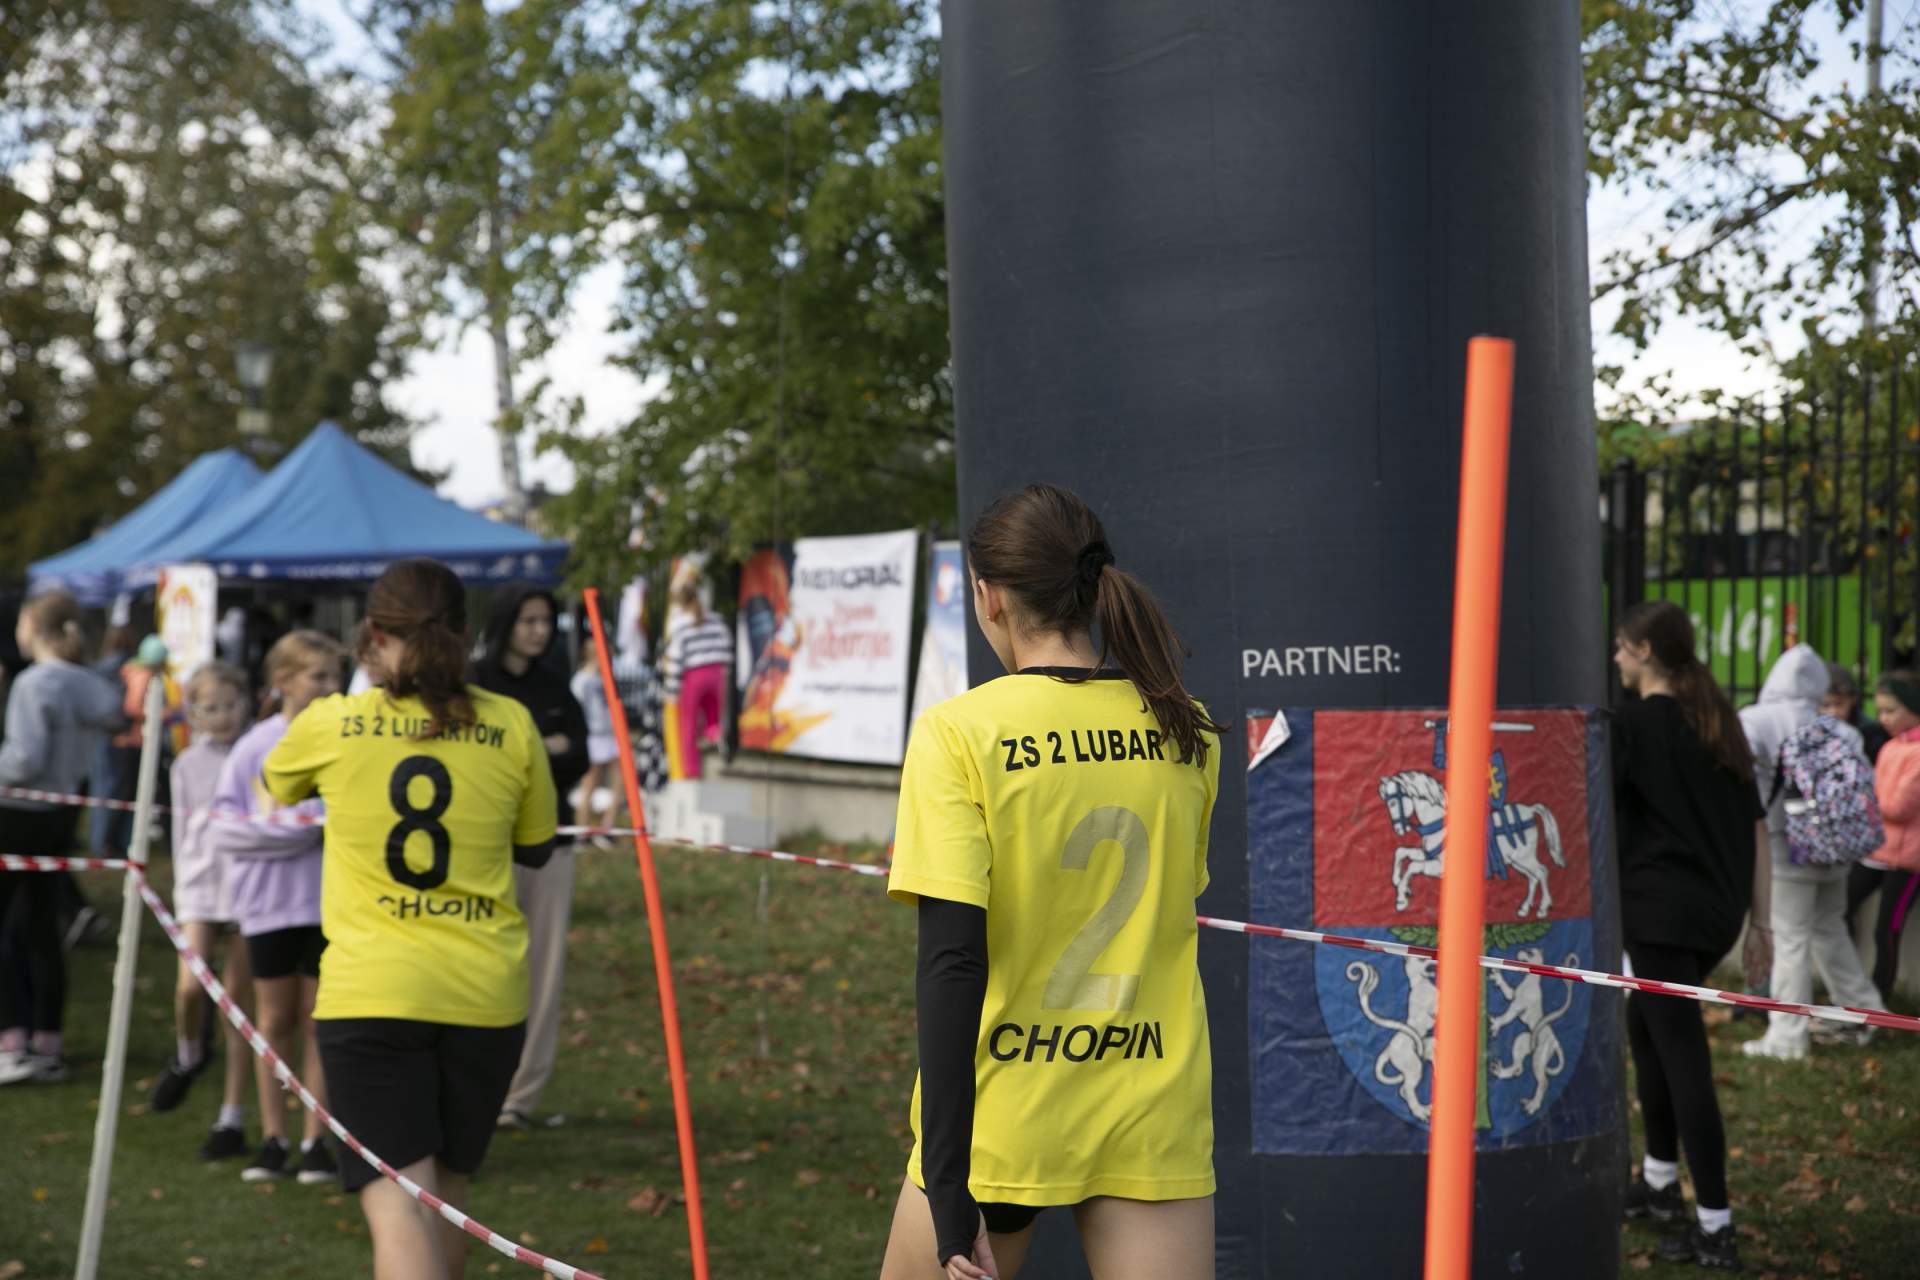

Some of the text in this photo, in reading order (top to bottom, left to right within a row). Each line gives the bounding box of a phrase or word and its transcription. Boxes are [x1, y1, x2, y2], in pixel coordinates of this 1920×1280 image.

[1242, 644, 1401, 678] PARTNER:
[341, 715, 364, 737] ZS
[373, 715, 384, 737] 2
[1001, 728, 1198, 772] ZS 2 LUBAR
[385, 754, 453, 891] 8
[1040, 805, 1151, 1012] 2
[988, 1021, 1164, 1063] CHOPIN
